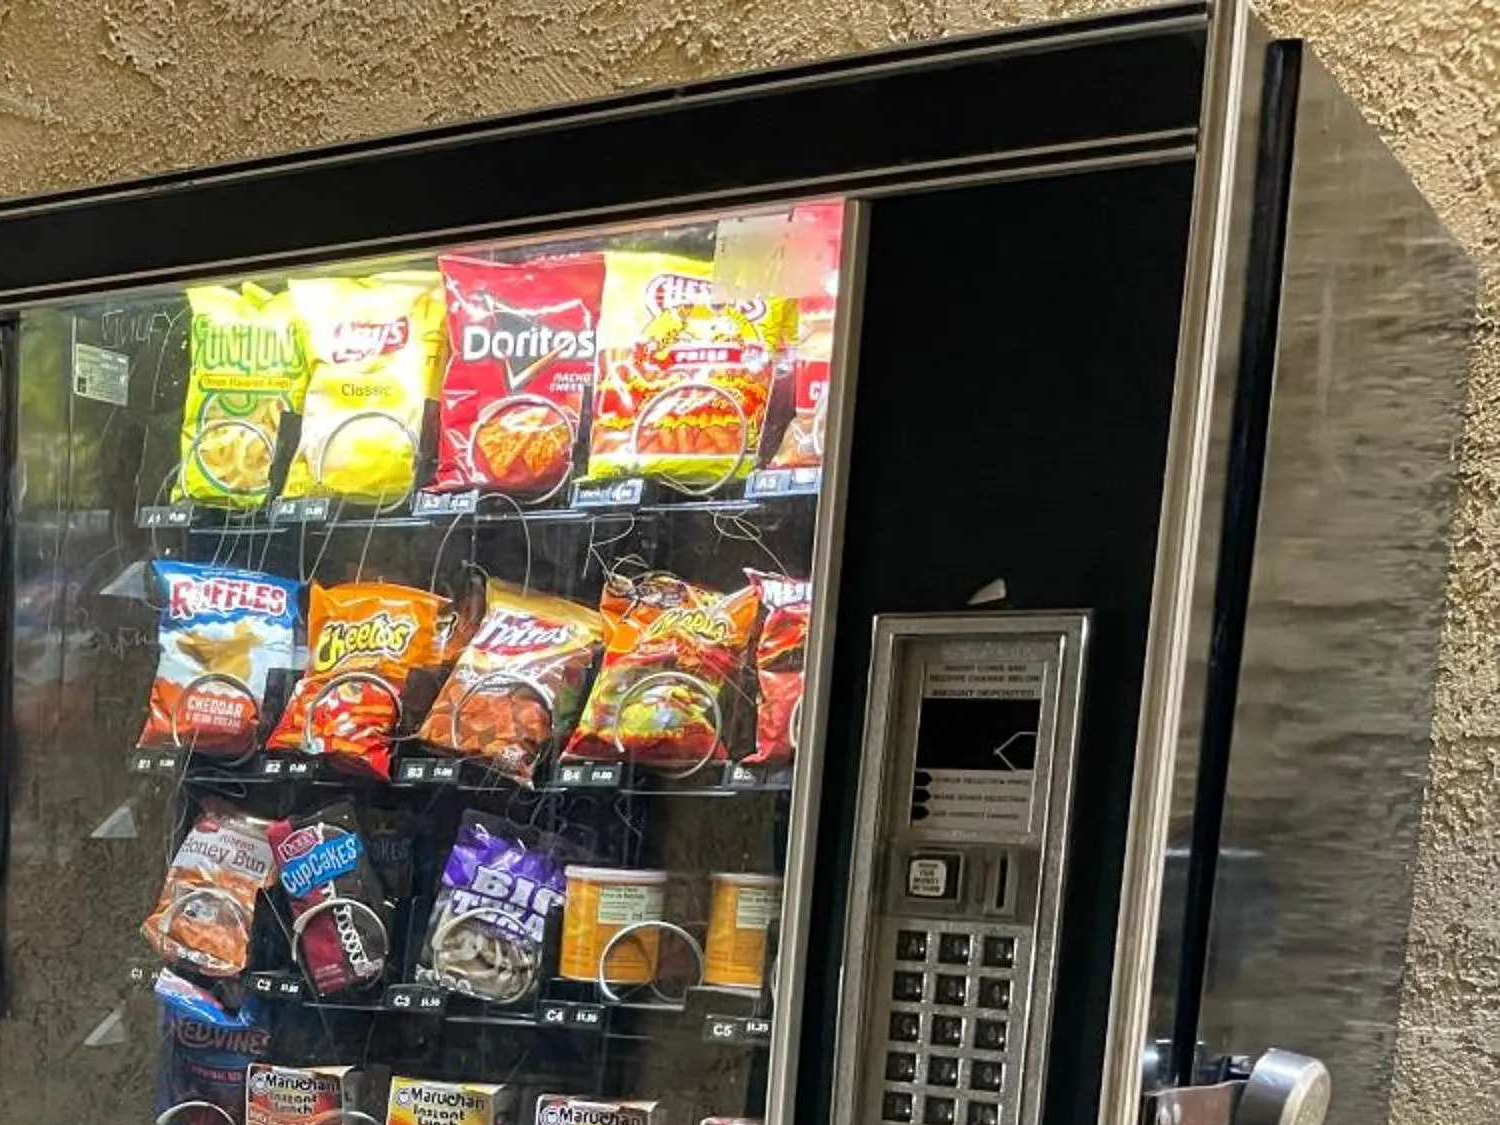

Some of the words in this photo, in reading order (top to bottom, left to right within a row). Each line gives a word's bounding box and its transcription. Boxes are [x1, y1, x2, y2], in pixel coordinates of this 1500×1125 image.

[463, 326, 596, 361] Doritos
[342, 383, 391, 398] Classic
[170, 579, 288, 620] RUFFLES
[313, 612, 414, 673] Cheetos
[187, 696, 245, 718] CHEDDAR
[232, 850, 266, 874] Bun
[257, 979, 271, 991] C2
[394, 995, 411, 1007] C3
[546, 1009, 563, 1022] C4
[265, 1073, 340, 1093] Maruchan
[410, 1087, 485, 1110] Maruchan
[413, 1104, 465, 1121] Instant
